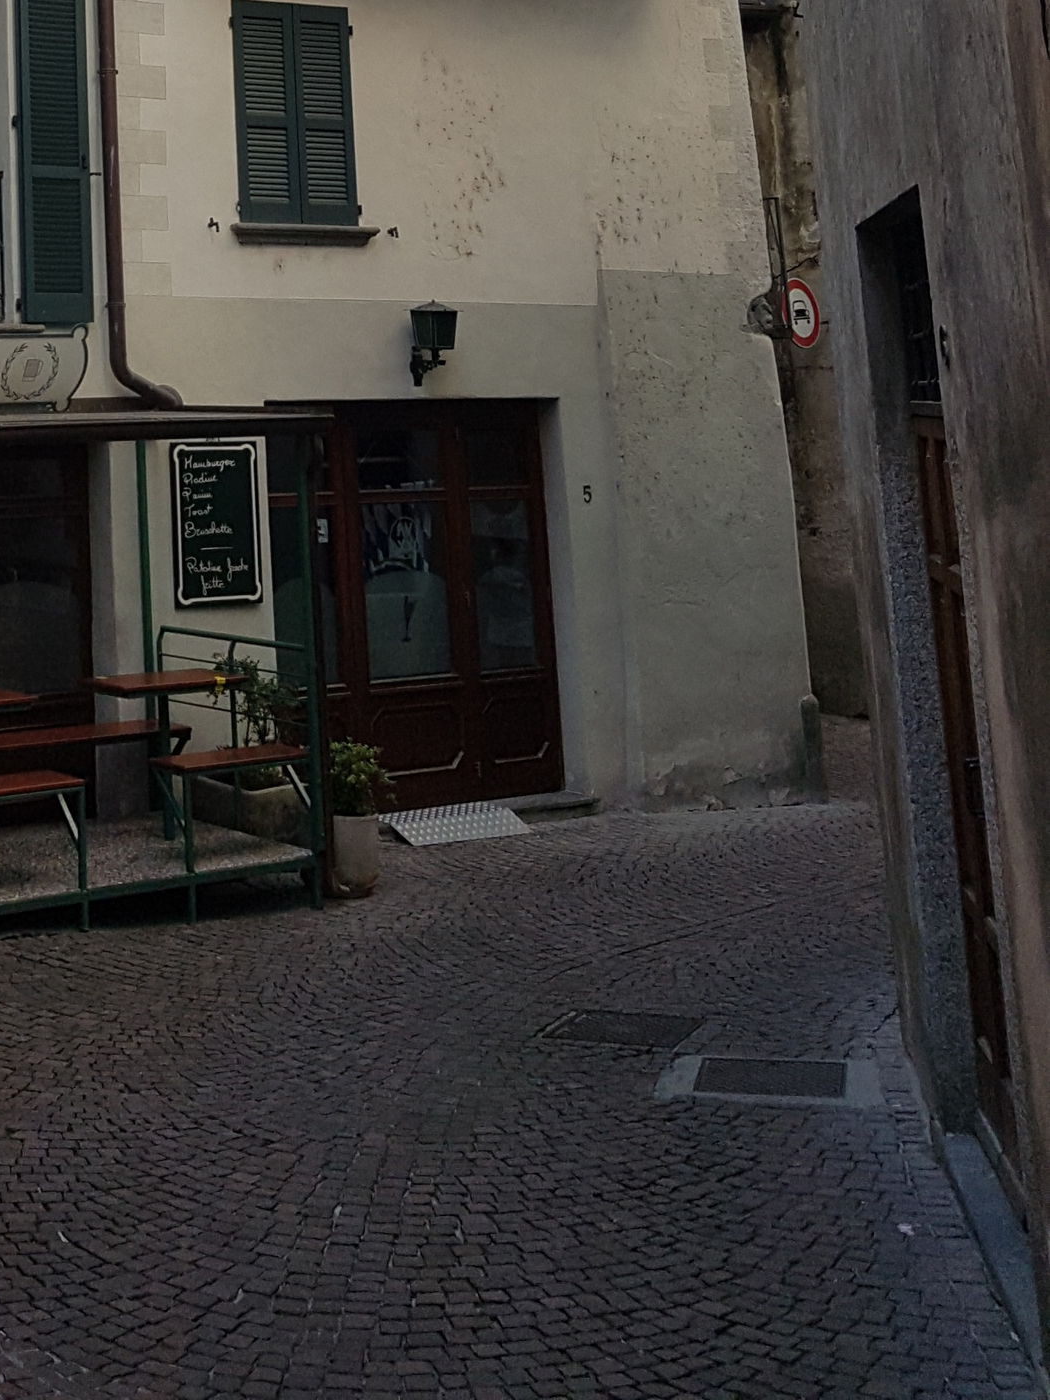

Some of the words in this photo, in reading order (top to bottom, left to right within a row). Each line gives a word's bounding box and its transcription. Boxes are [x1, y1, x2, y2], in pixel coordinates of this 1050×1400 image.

[184, 455, 236, 472] Hamburger
[182, 472, 218, 485] Piadine
[583, 485, 592, 503] 5
[184, 503, 213, 517] Toast
[184, 521, 233, 538] Bruschette
